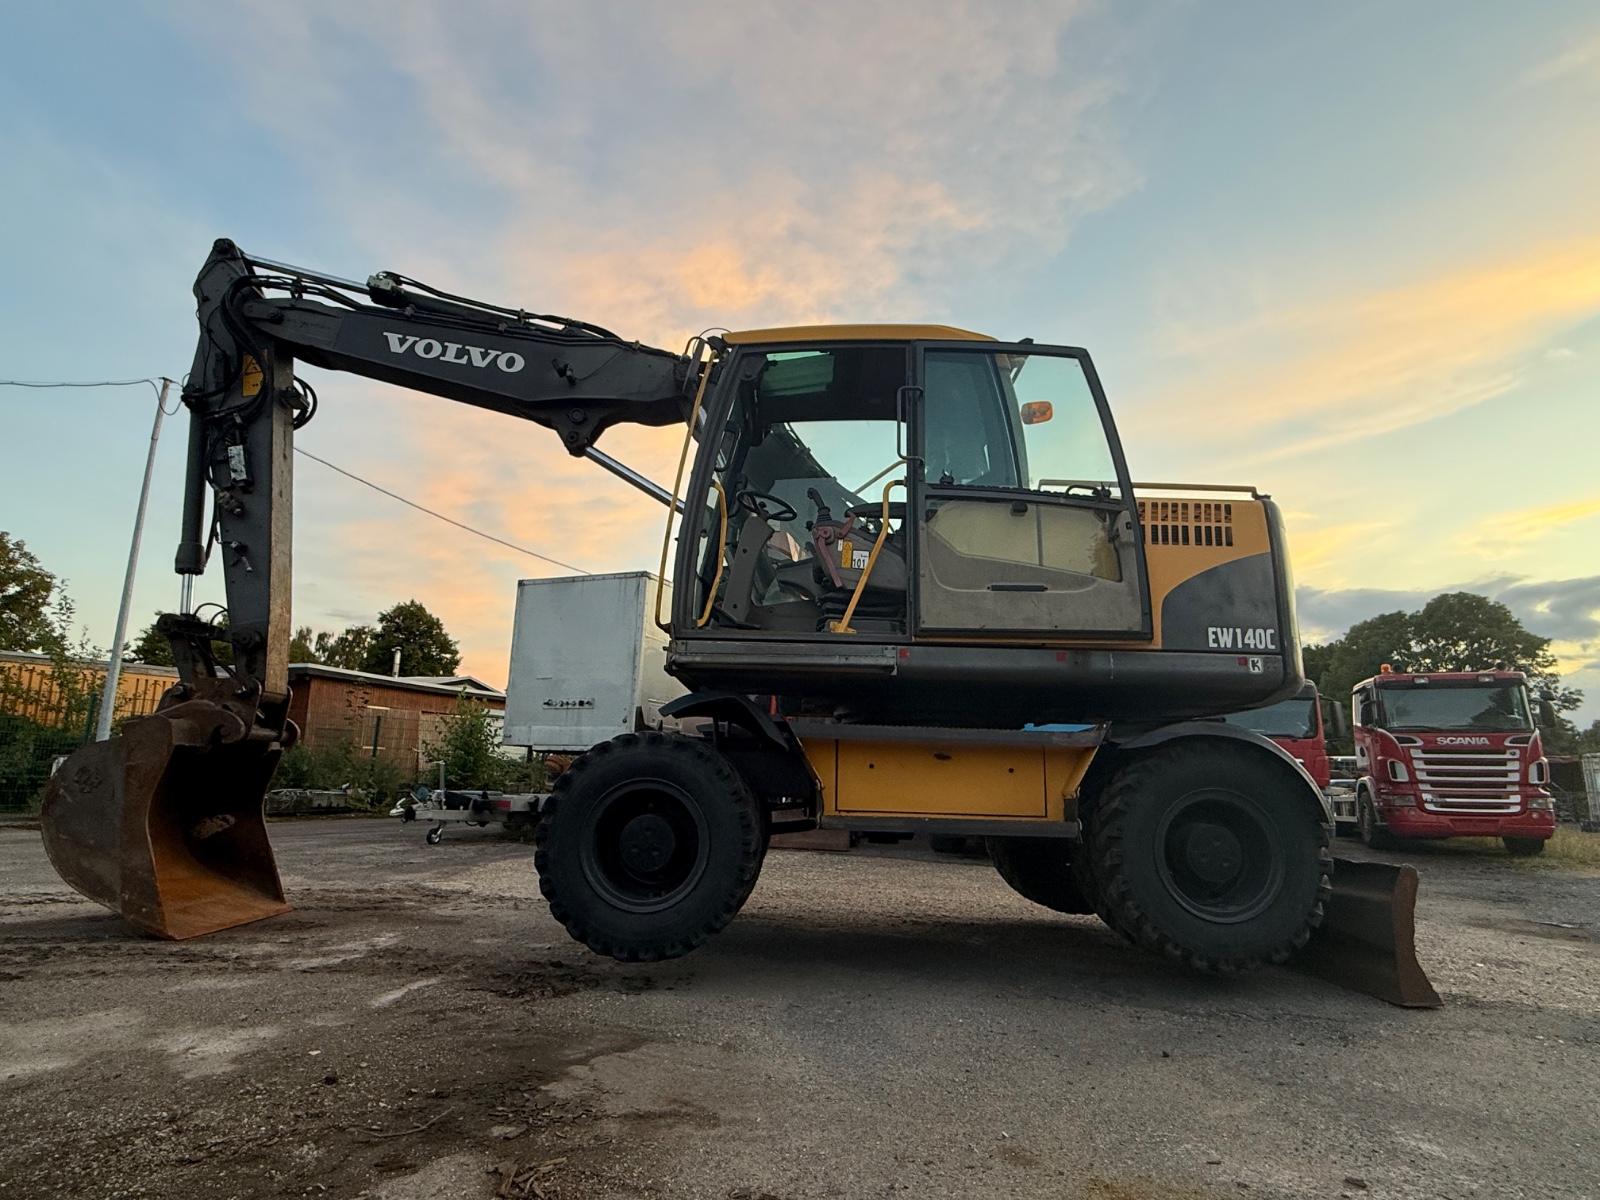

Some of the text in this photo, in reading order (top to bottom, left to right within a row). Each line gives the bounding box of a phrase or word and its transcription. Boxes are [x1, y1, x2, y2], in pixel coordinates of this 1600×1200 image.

[383, 332, 525, 373] VOLVO
[1207, 627, 1276, 650] EW140C
[1436, 737, 1490, 745] SCANIA
